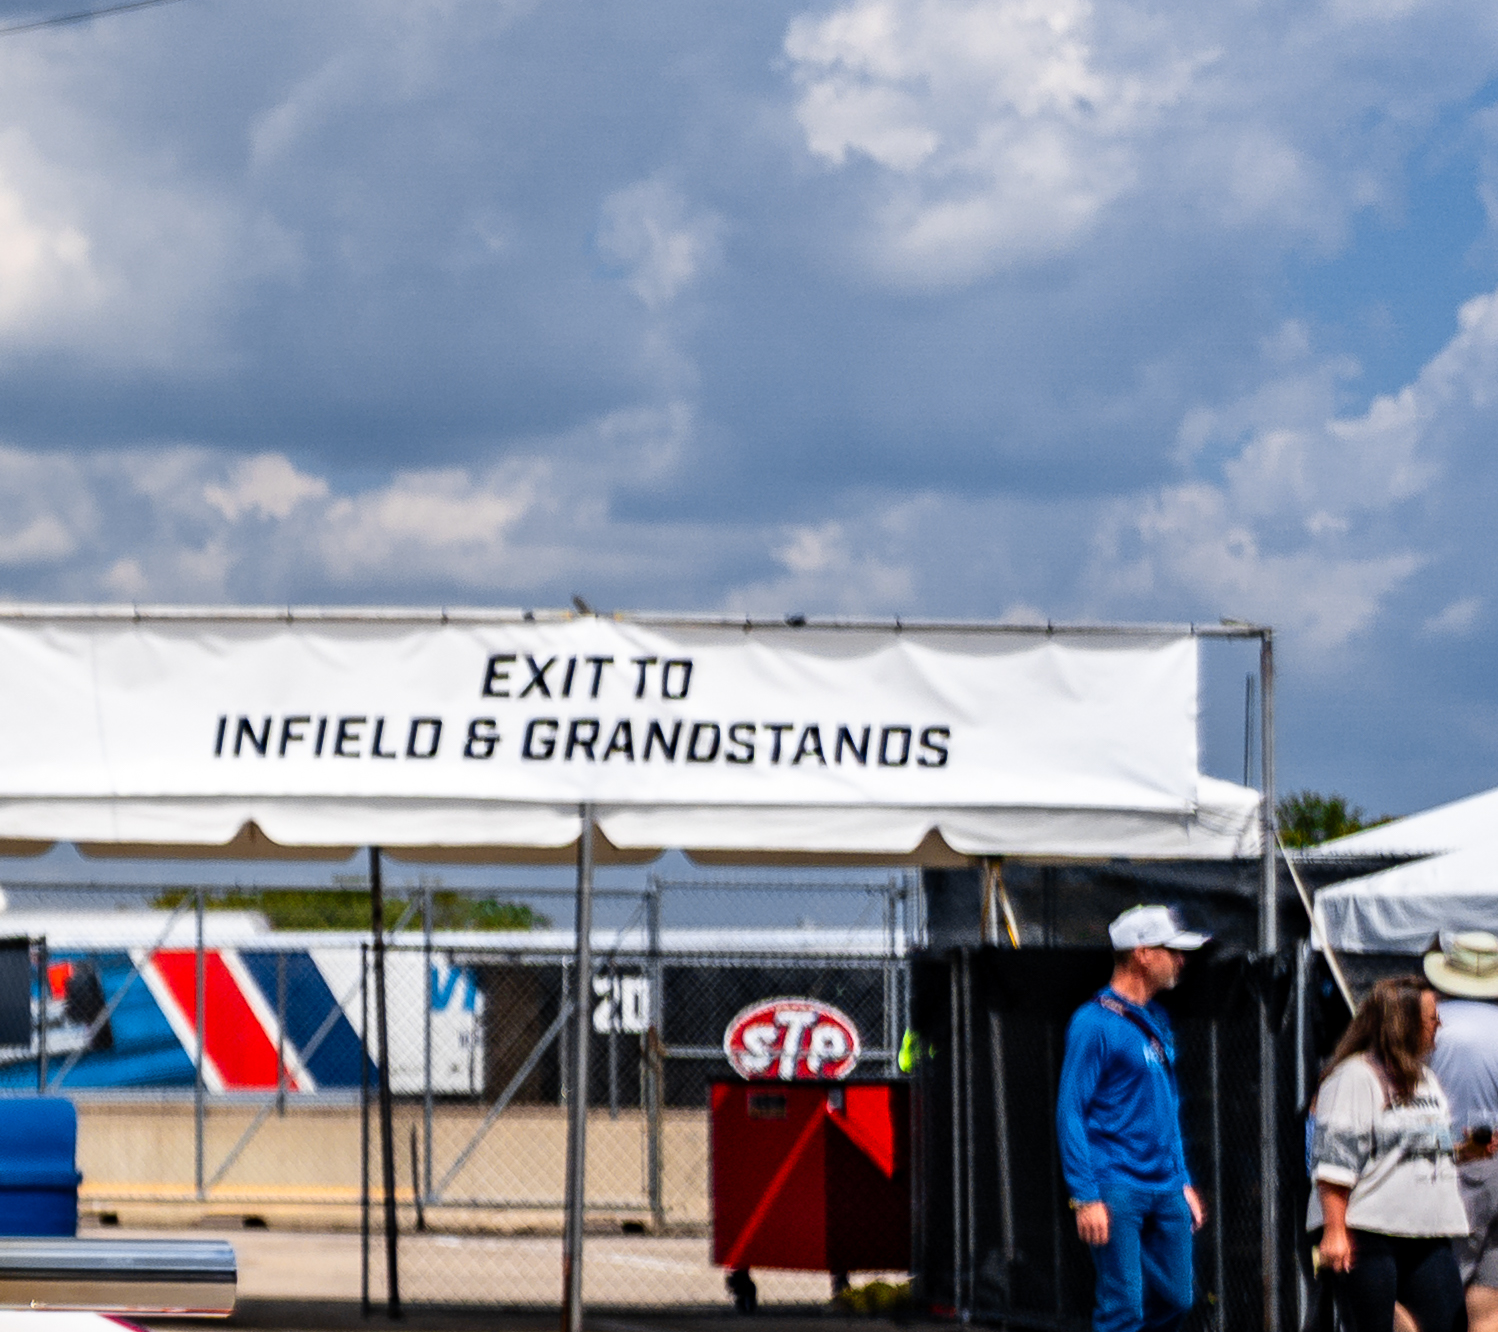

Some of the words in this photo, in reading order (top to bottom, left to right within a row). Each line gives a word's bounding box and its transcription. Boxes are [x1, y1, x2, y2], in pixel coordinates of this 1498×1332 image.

[480, 652, 616, 699] EXIT
[630, 654, 695, 700] TO
[213, 716, 442, 760] INFIELD
[462, 718, 501, 759] &
[520, 717, 952, 769] GRANDSTANDS
[739, 1010, 848, 1081] STP
